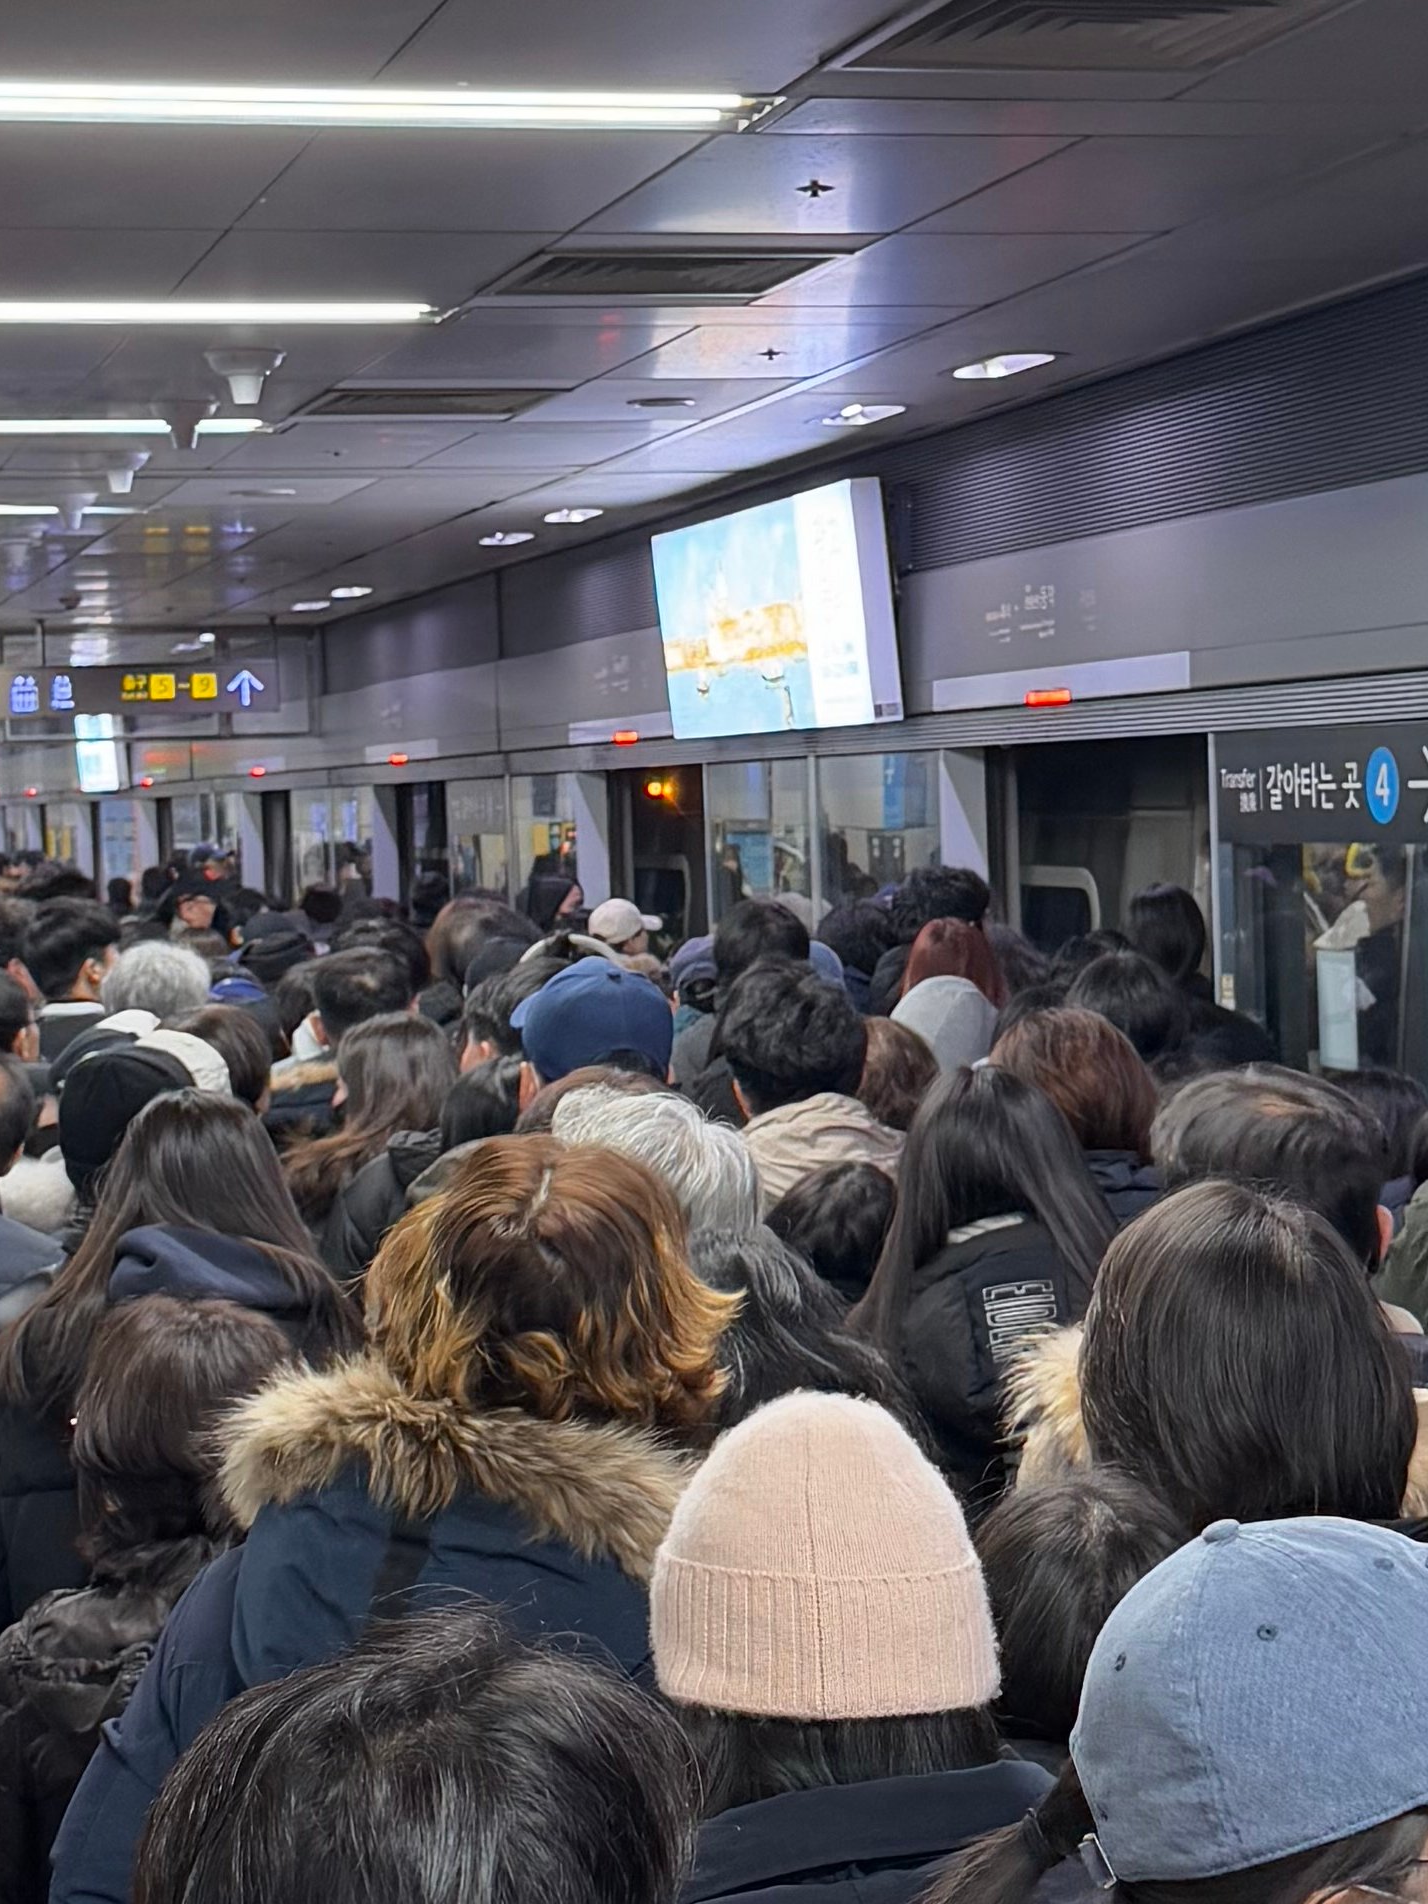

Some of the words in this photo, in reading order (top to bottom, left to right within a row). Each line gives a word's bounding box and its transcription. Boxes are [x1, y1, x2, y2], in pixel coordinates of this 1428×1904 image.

[1220, 767, 1257, 789] Transfer
[1266, 761, 1337, 811] 갈아타는
[1341, 761, 1362, 809] 곳
